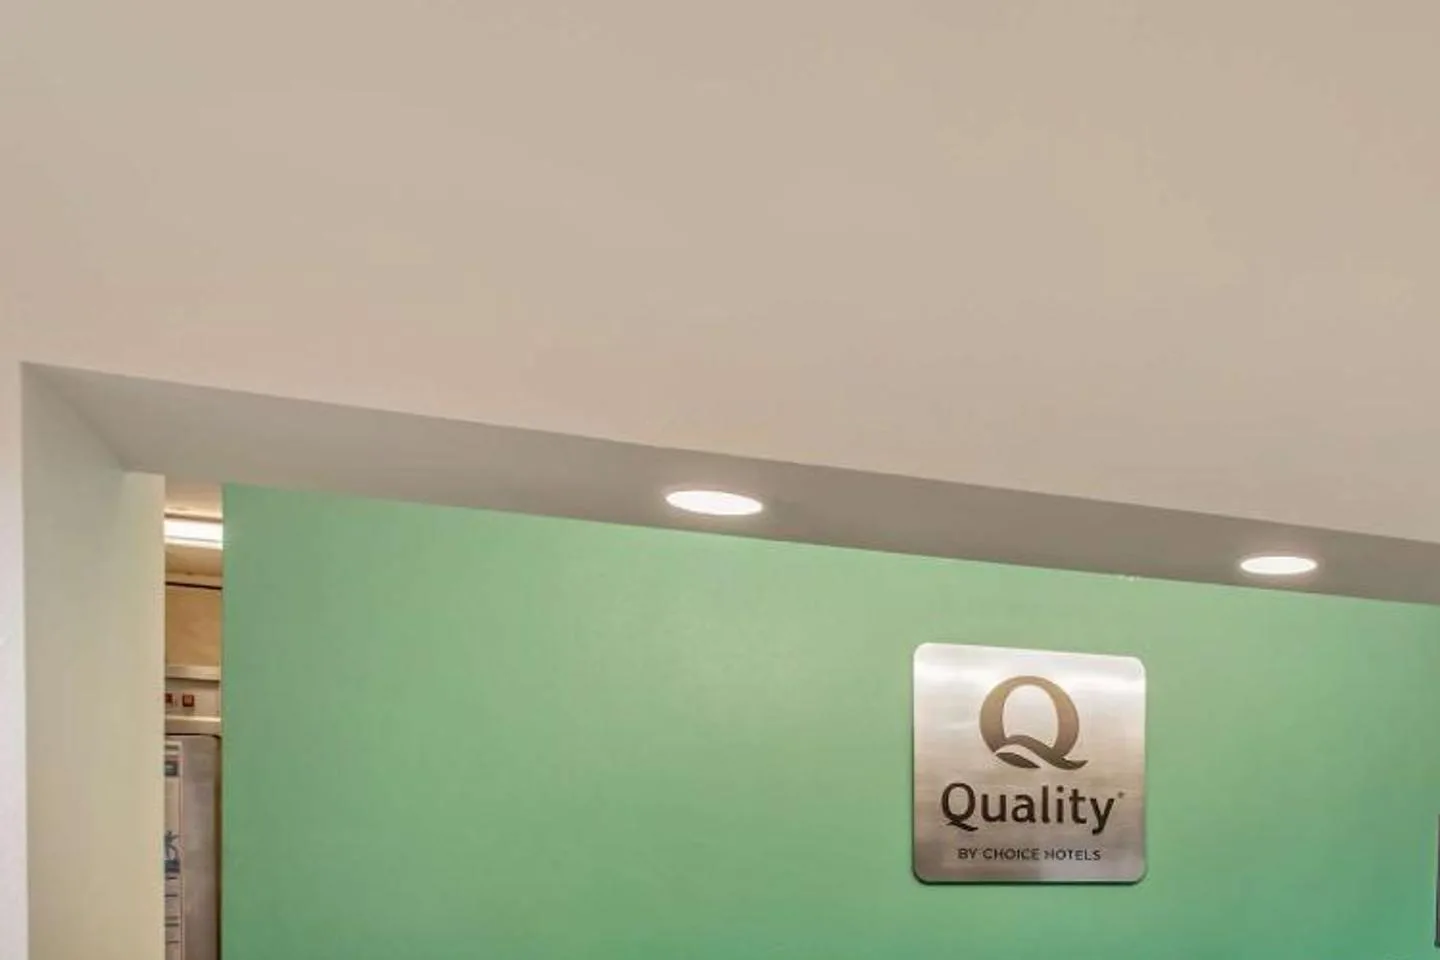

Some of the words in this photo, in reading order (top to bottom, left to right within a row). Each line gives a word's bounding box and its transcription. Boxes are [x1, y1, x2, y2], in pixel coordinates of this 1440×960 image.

[941, 782, 1116, 836] Quality
[957, 848, 977, 860] BY
[982, 848, 1040, 861] CHOICE
[1044, 849, 1101, 861] HOTELS
